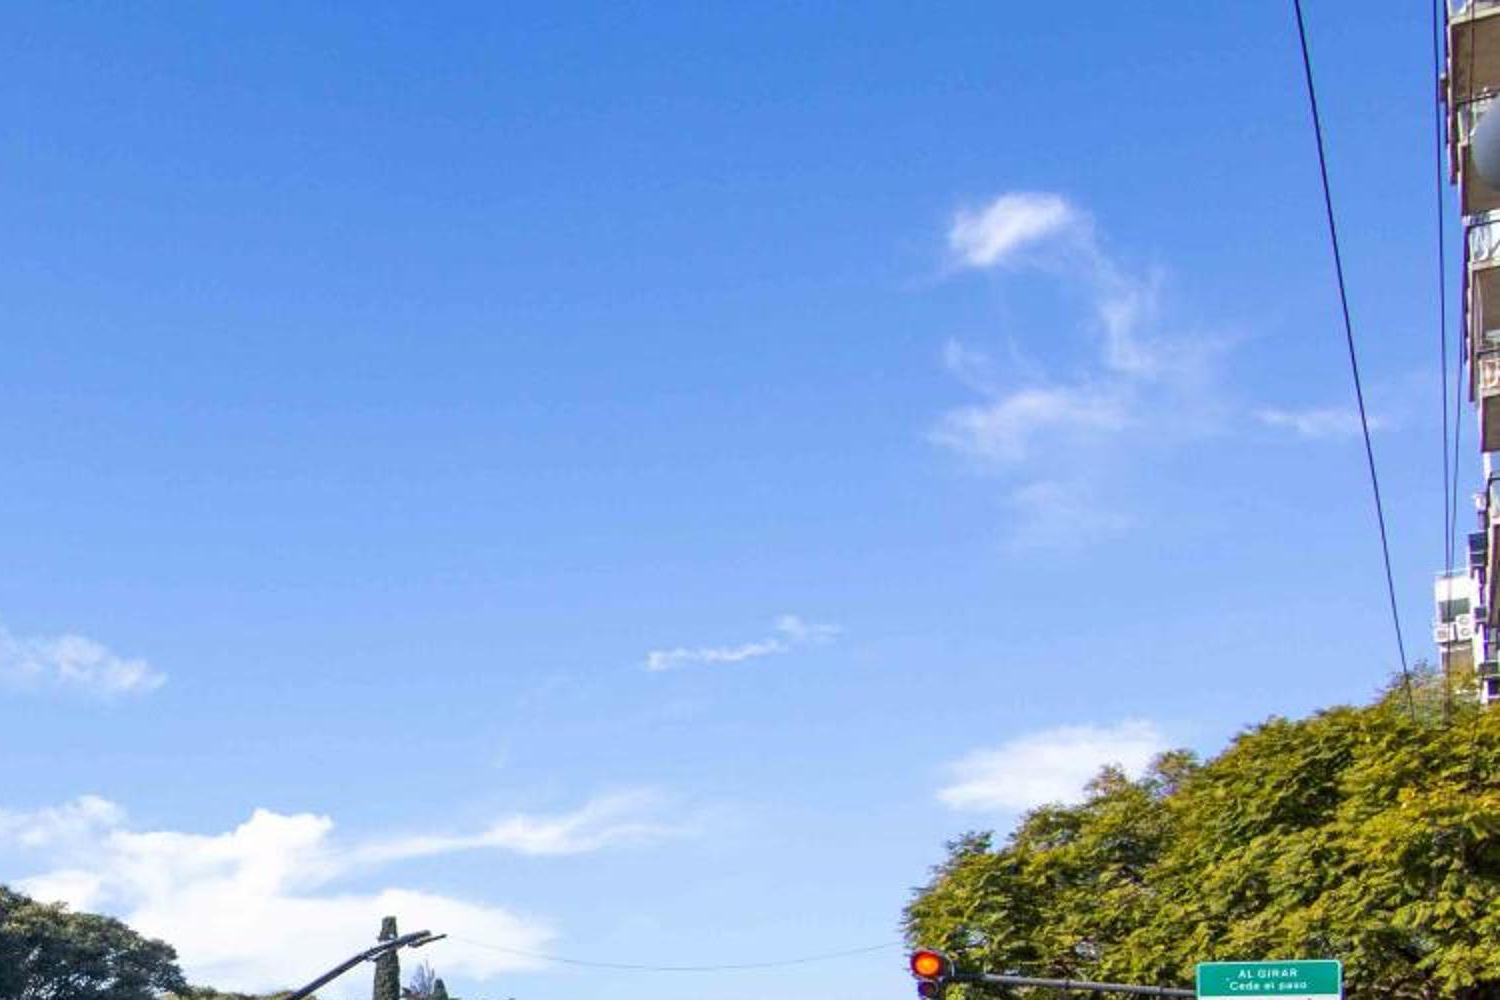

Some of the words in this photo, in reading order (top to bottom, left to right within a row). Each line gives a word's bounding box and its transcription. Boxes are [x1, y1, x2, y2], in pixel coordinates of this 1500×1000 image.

[1238, 968, 1253, 979] AL
[1257, 967, 1299, 979] GIRAR
[1229, 981, 1260, 991] Cede
